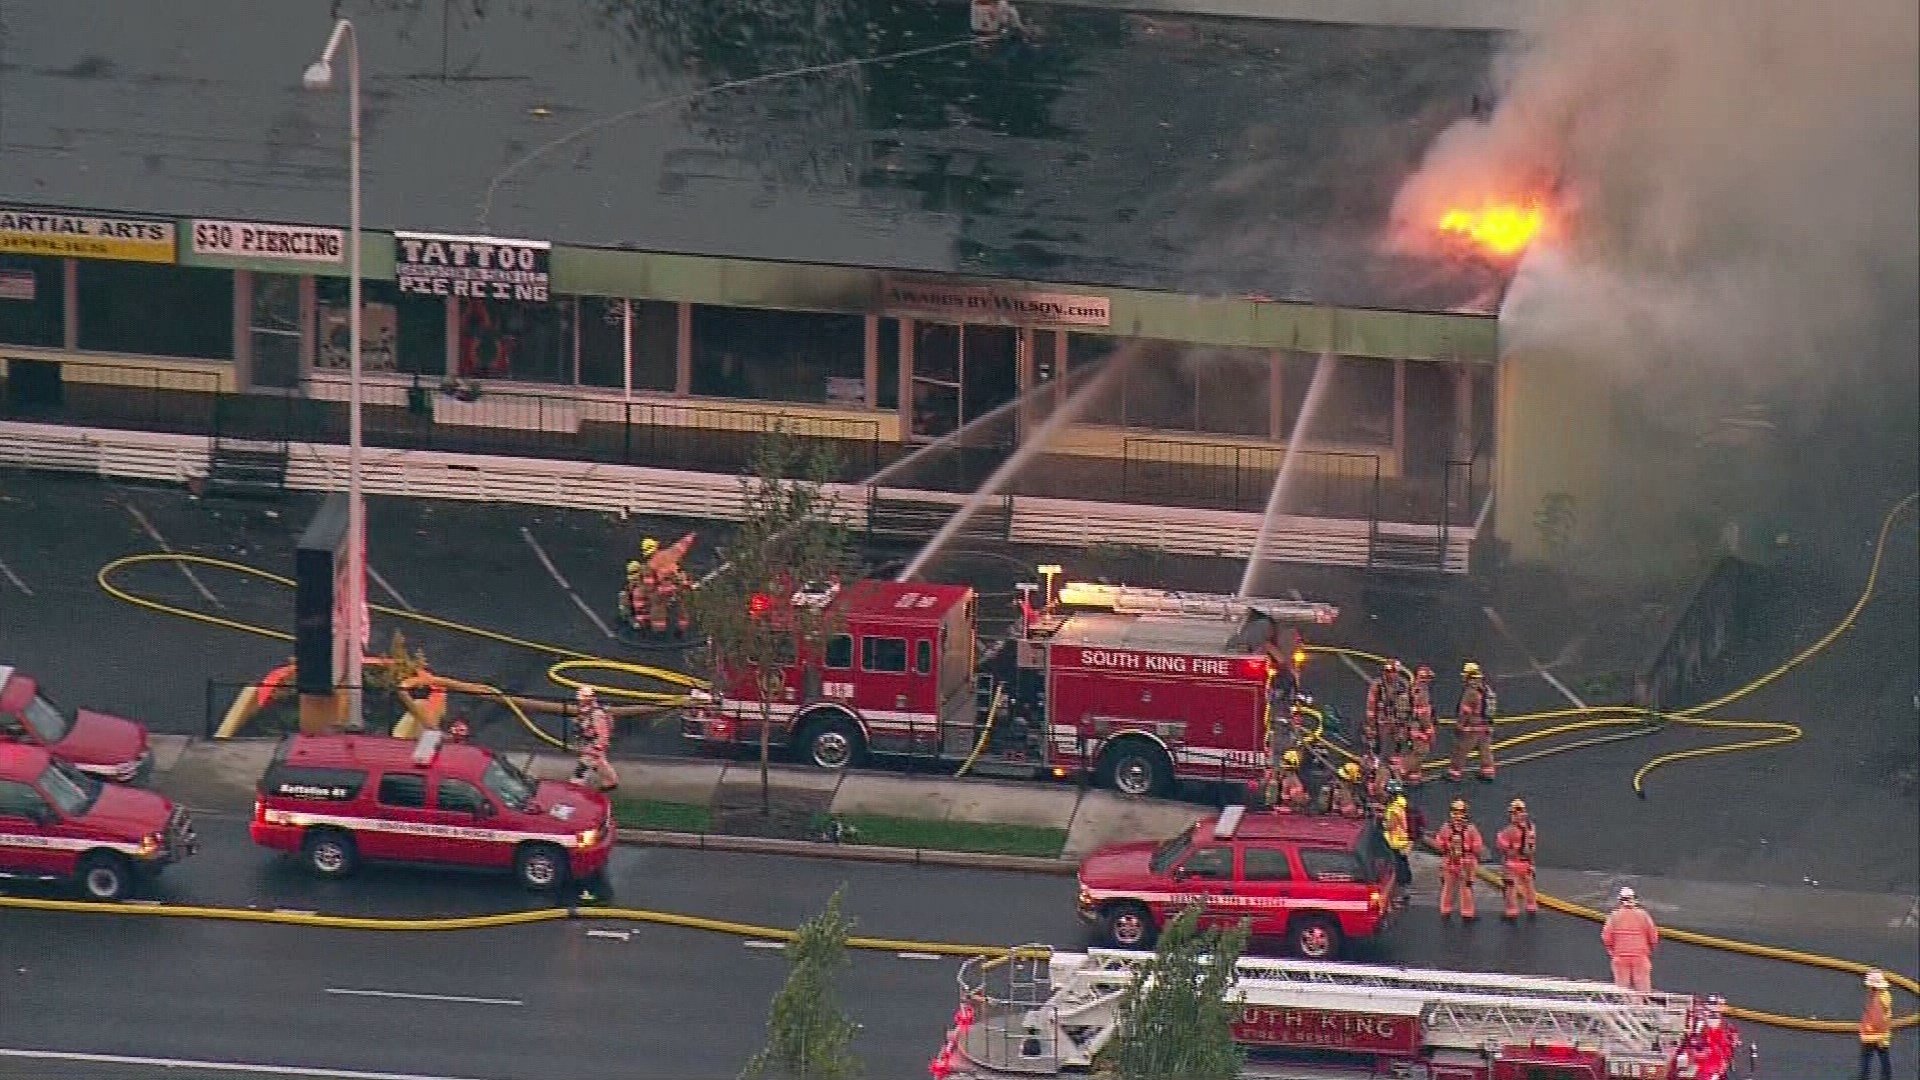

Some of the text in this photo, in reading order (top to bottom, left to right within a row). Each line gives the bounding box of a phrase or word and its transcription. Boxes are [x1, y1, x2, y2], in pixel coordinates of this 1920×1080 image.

[0, 213, 165, 241] ARTIAL ARTS
[195, 223, 342, 257] $30 PIERCING
[0, 236, 108, 252] UPPLIES
[401, 239, 535, 270] TATTOO
[399, 276, 549, 302] PIERCING
[1080, 649, 1230, 675] SOUTH KING FIRE
[1243, 1006, 1394, 1038] UTH KING
